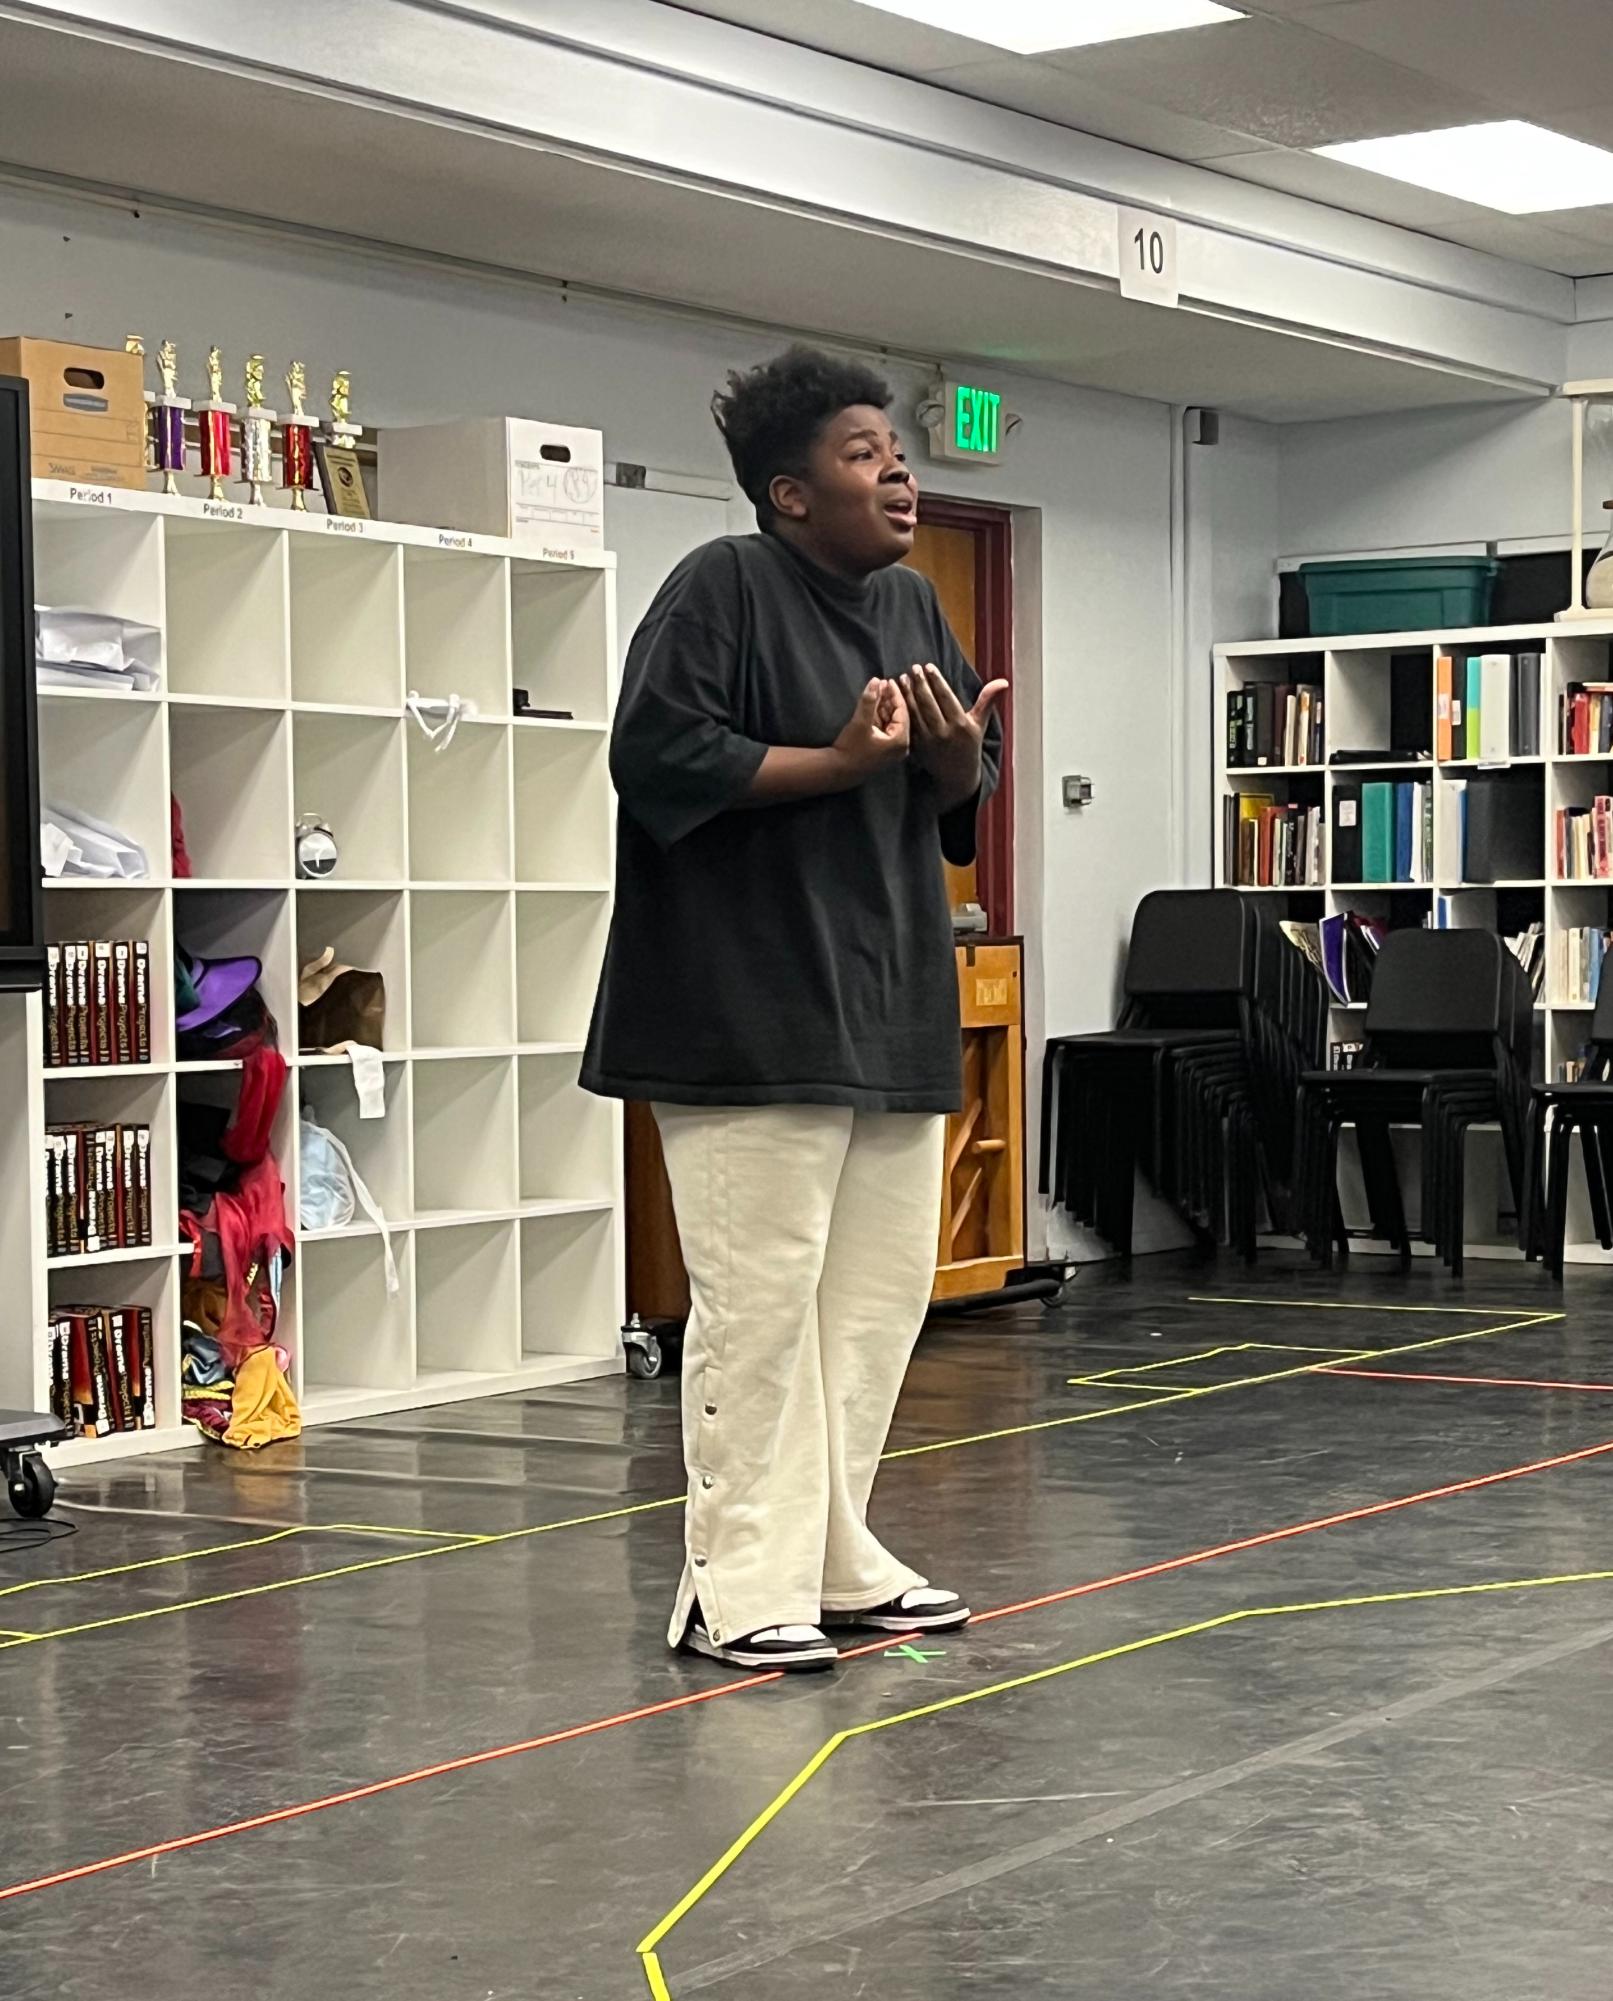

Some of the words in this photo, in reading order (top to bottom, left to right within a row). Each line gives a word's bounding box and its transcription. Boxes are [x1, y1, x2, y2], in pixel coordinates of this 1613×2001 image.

[1133, 227, 1164, 275] 10
[956, 386, 1001, 454] EXIT
[69, 487, 104, 504] Period
[107, 492, 112, 505] 1
[203, 503, 235, 519] Period
[237, 509, 243, 519] 2
[326, 518, 356, 533] Period
[438, 533, 466, 548] Period
[542, 547, 568, 561] Period
